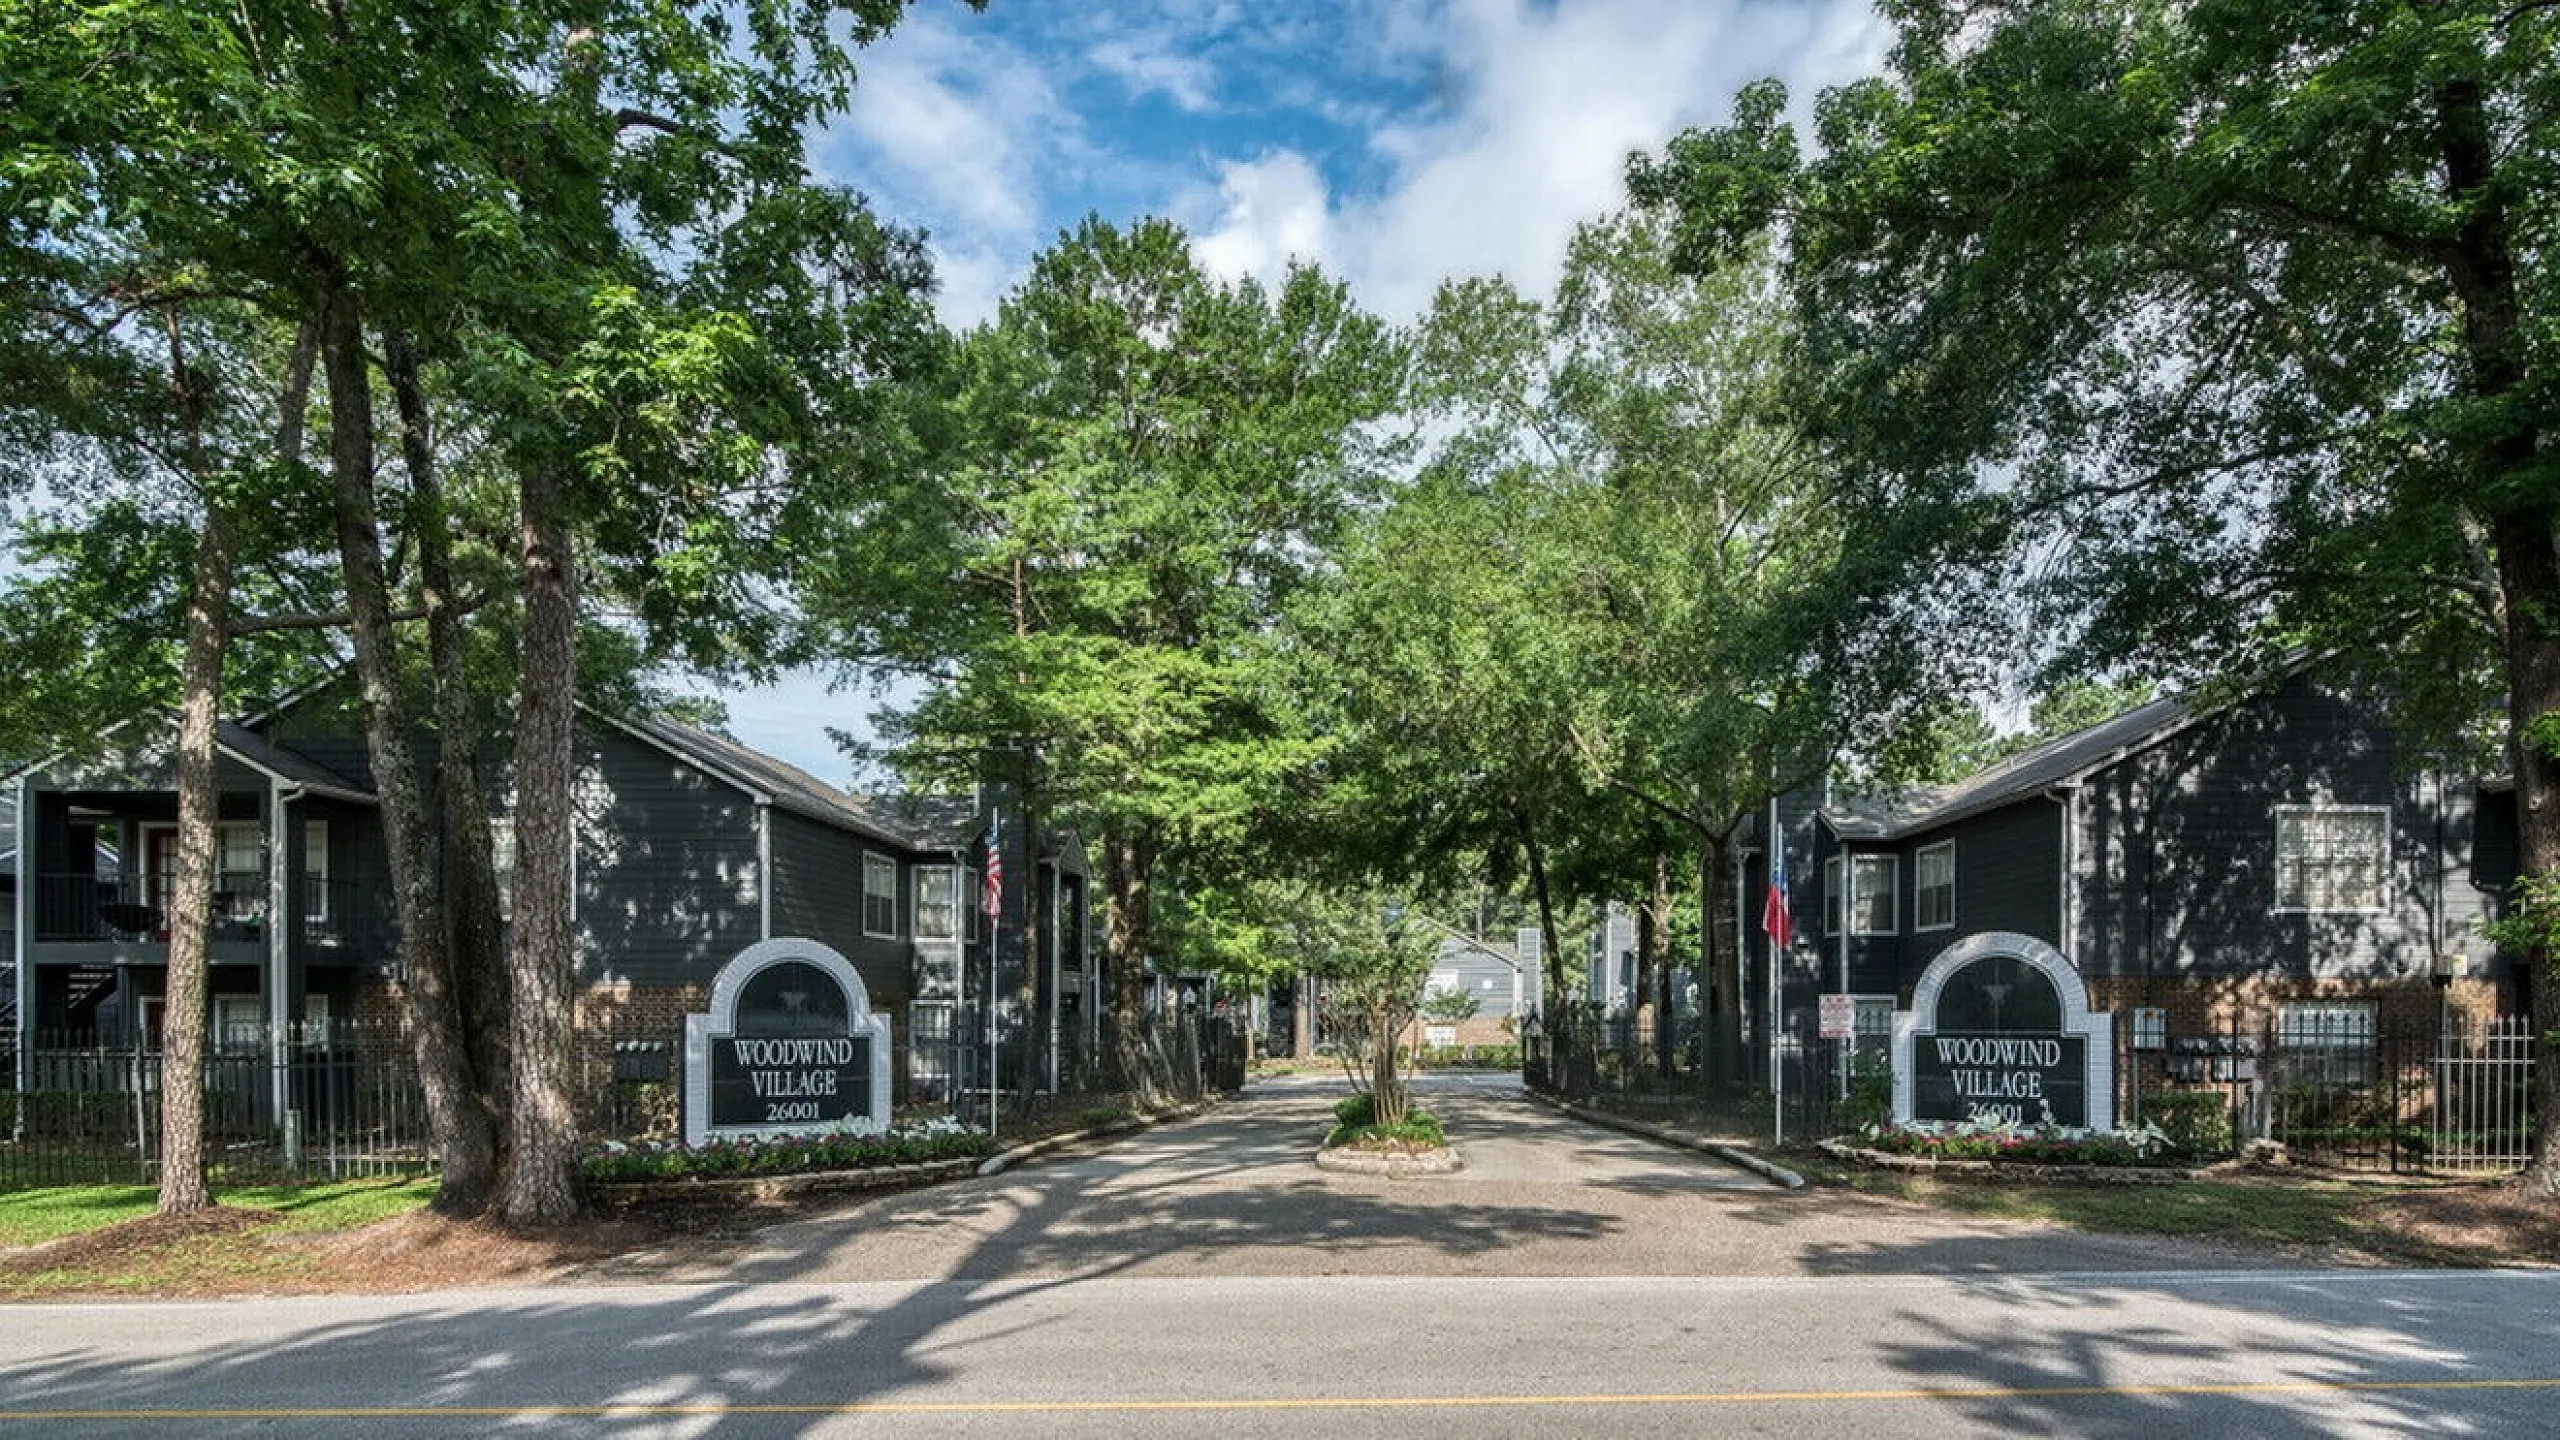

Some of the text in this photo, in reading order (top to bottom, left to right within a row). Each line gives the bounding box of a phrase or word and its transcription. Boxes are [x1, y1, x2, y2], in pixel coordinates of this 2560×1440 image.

[734, 1038, 853, 1066] WOODWIND
[1936, 1038, 2061, 1067] WOODWIND
[751, 1069, 837, 1097] VILLAGE
[1952, 1069, 2041, 1098] VILLAGE
[766, 1102, 819, 1121] 26001
